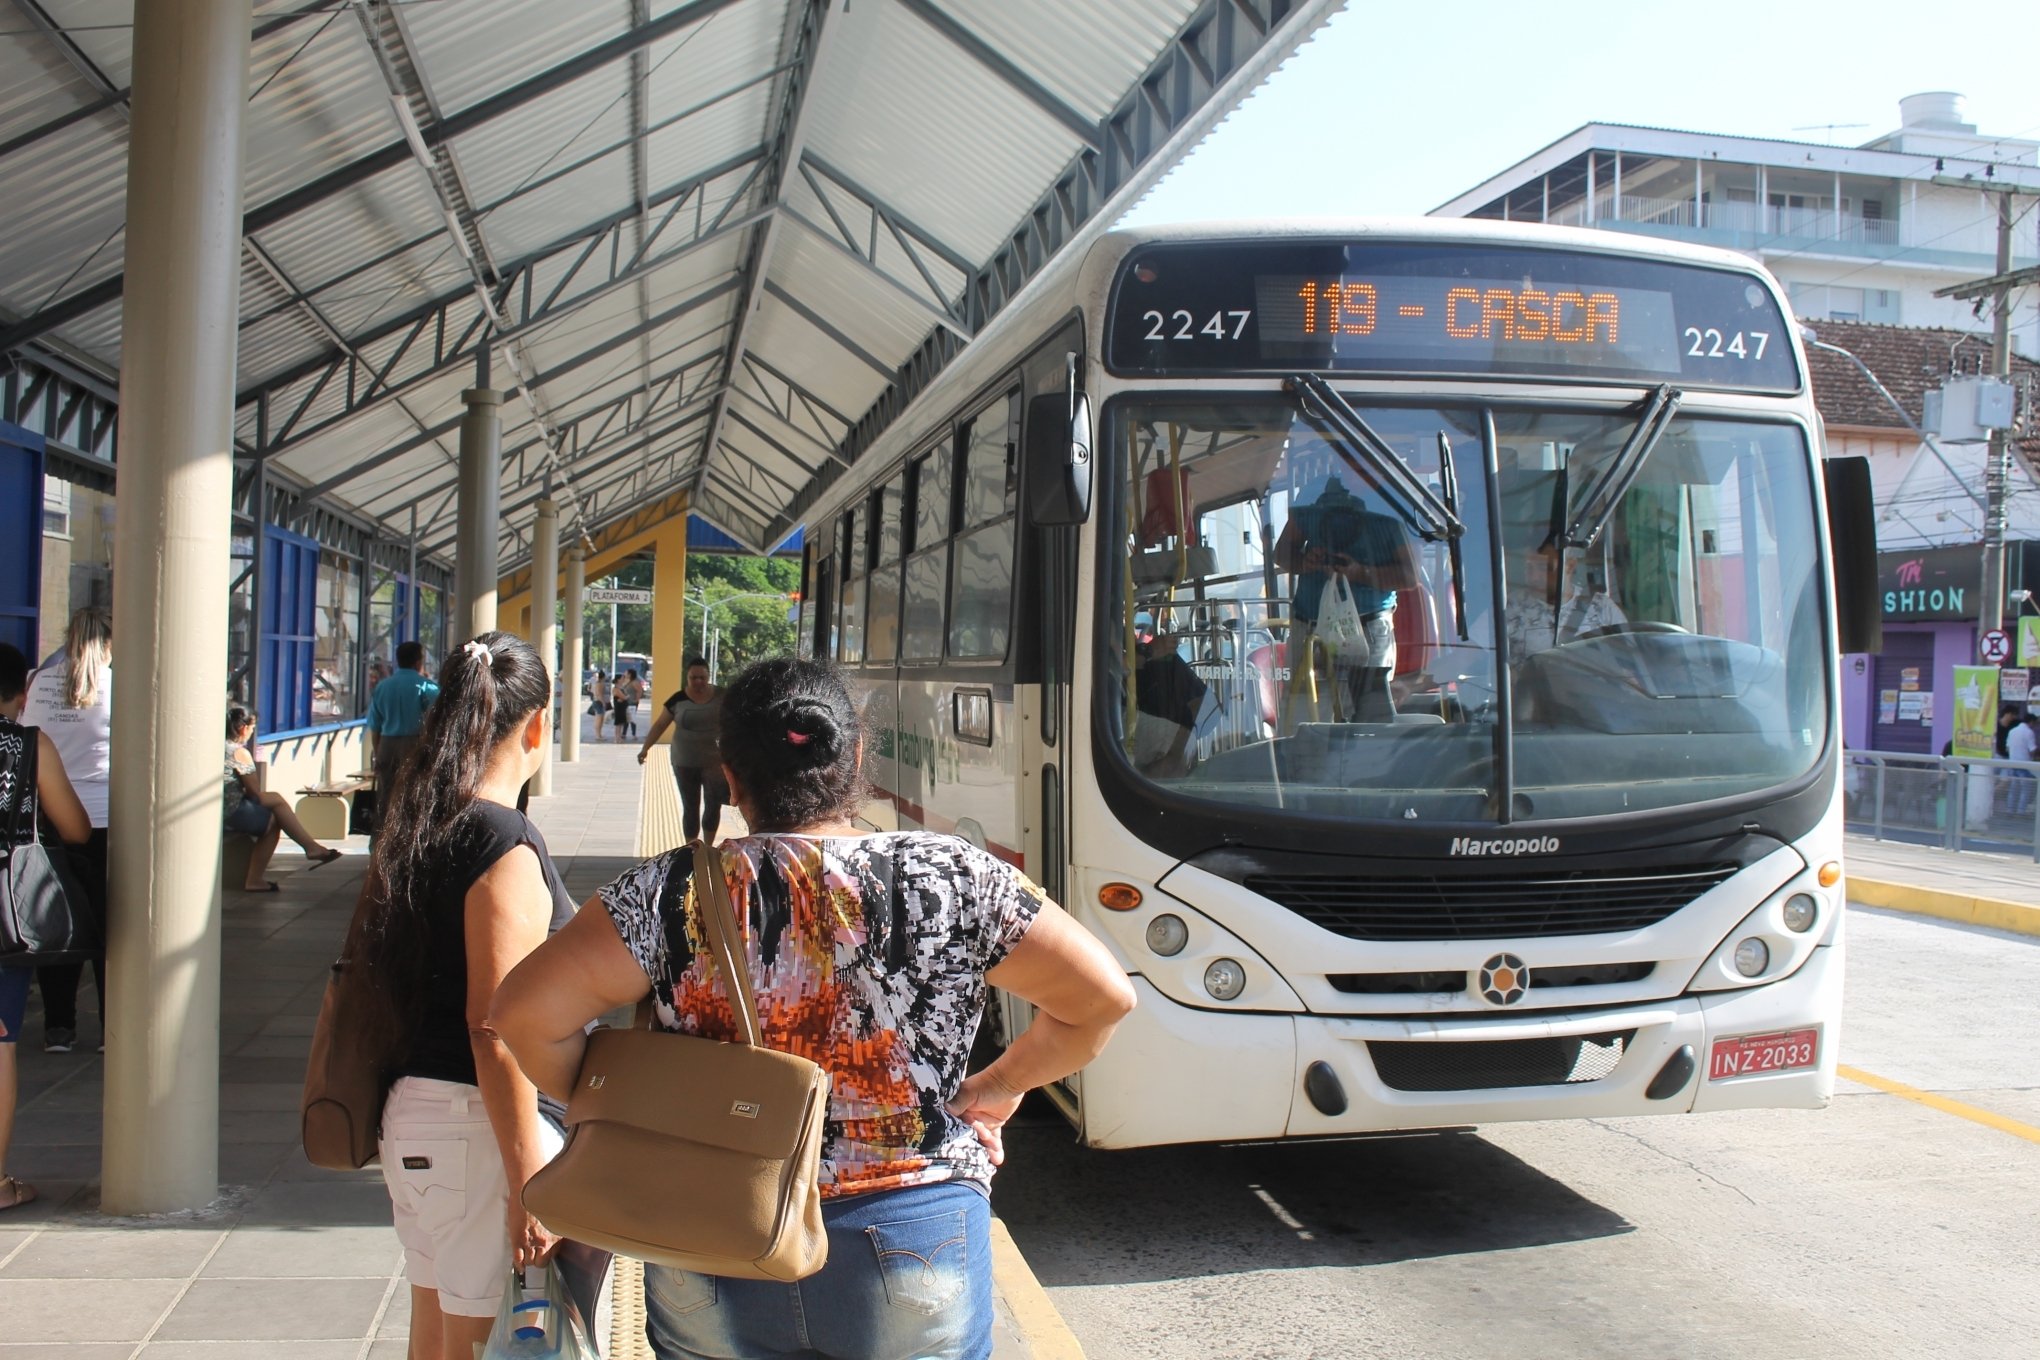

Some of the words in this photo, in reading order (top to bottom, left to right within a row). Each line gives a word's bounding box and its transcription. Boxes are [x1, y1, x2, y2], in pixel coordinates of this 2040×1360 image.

[1143, 309, 1251, 340] 2247
[1299, 282, 1376, 334] 119
[1399, 305, 1424, 316] -
[1447, 287, 1618, 343] CASCA
[1684, 327, 1769, 360] 2247
[593, 592, 640, 601] PLATAFORMA
[1884, 587, 1964, 614] SHION
[1450, 835, 1559, 856] Marcopolo
